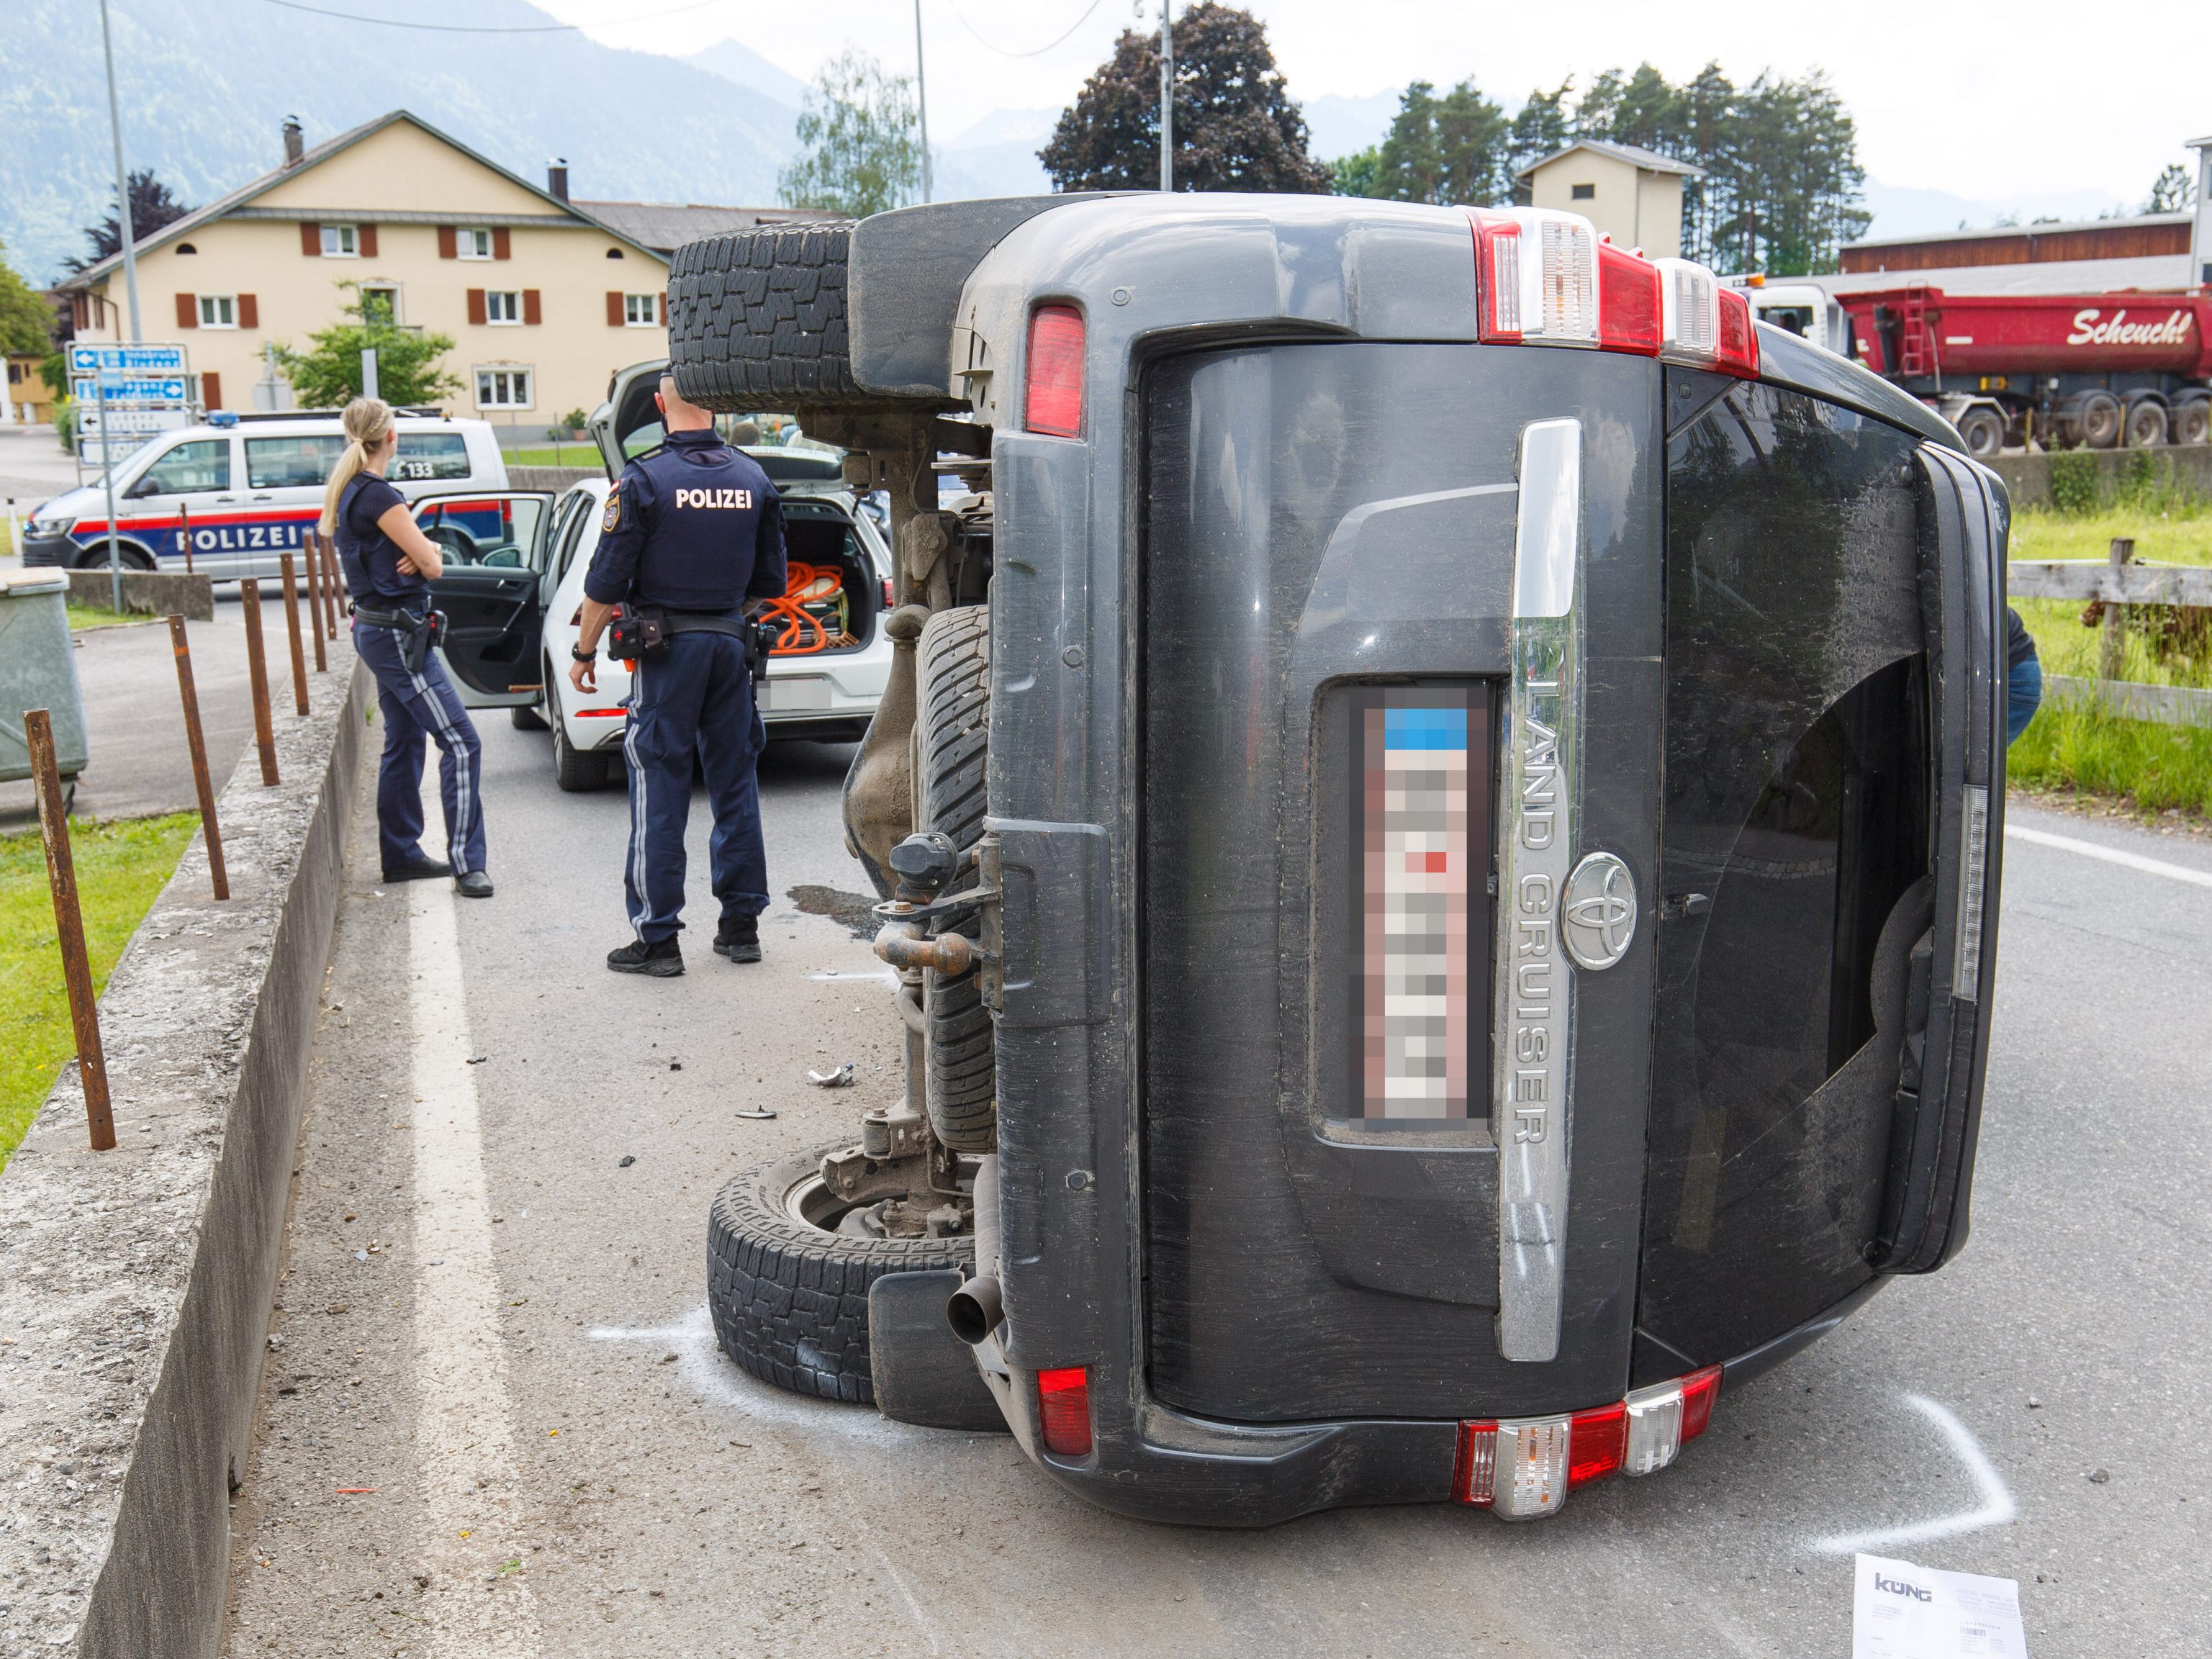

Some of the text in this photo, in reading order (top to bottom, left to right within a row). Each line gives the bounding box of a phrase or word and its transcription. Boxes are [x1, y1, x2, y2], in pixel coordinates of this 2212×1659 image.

[407, 461, 434, 478] 133
[676, 489, 752, 509] POLIZEI
[176, 525, 297, 551] POLIZEI
[1514, 681, 1561, 1144] LAND CRUISER
